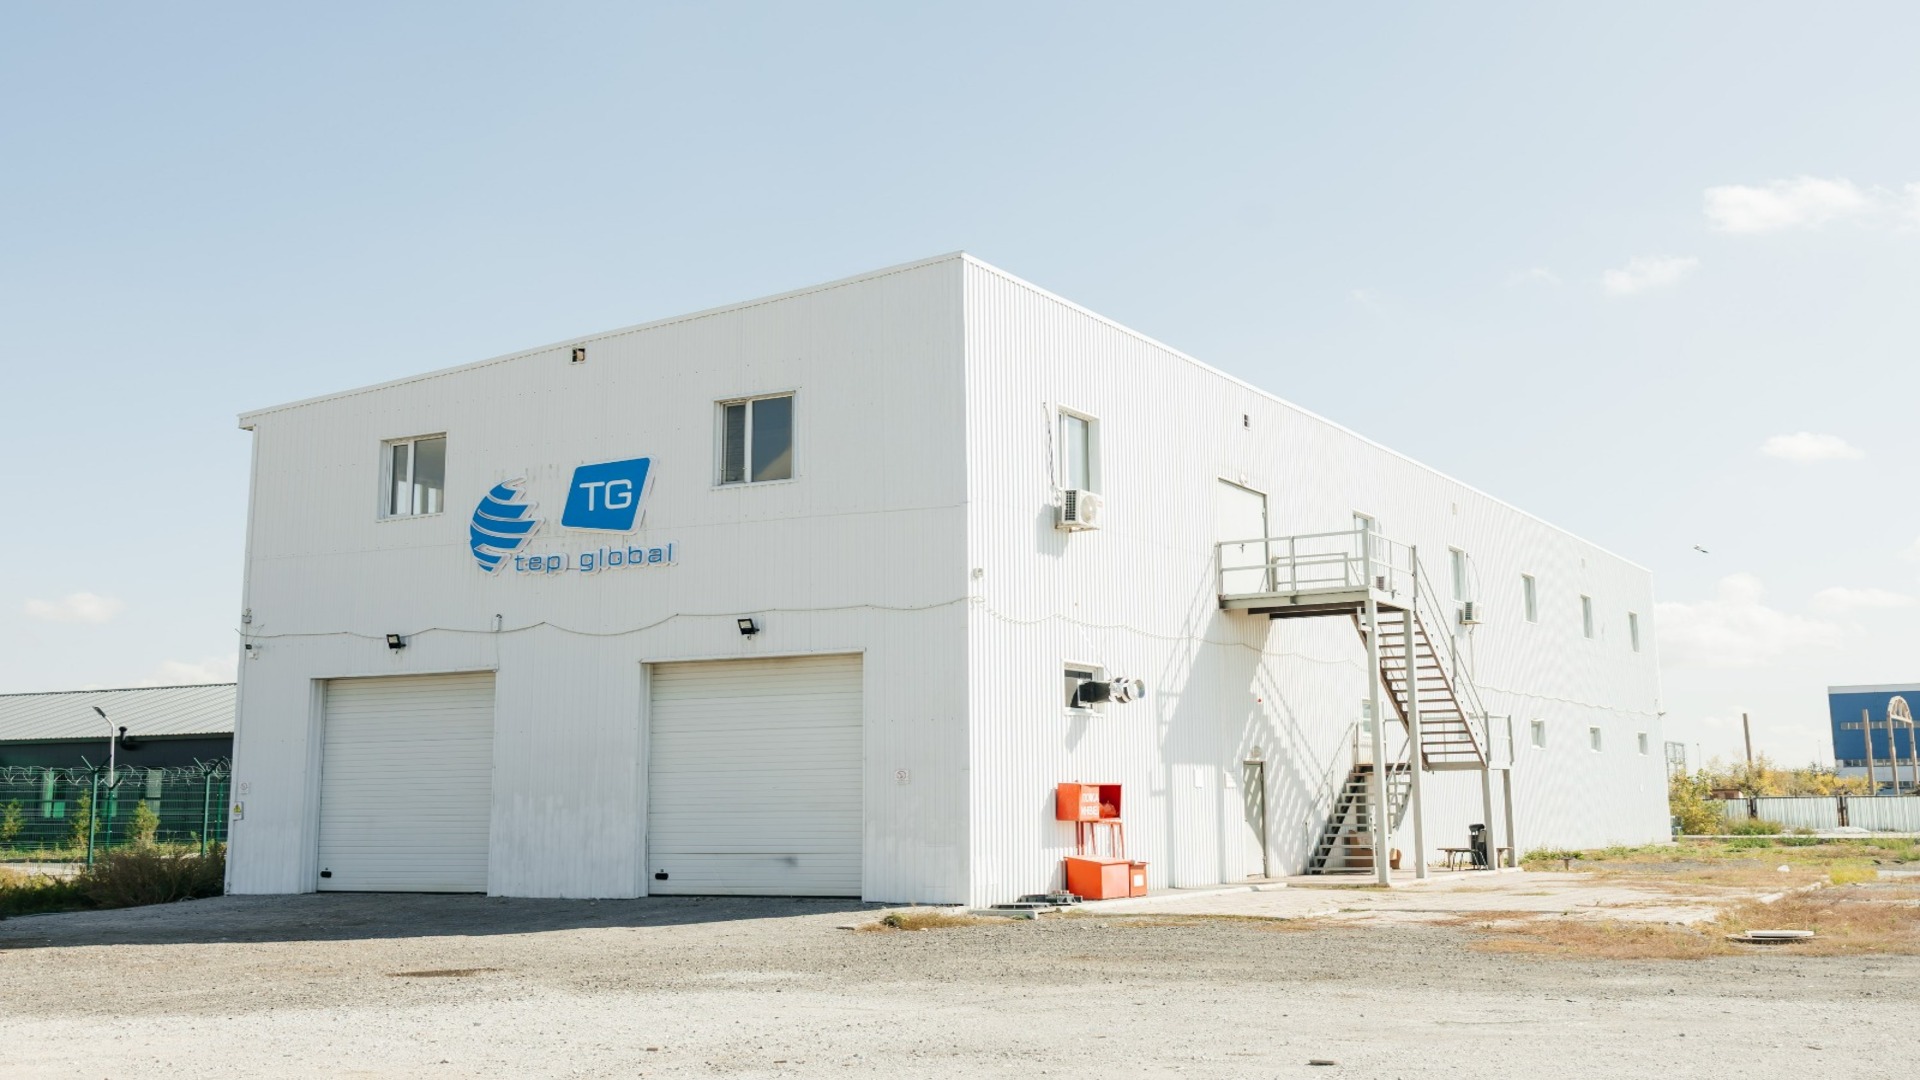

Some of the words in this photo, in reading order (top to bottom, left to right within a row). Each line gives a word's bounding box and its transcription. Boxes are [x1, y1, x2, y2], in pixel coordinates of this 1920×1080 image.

[579, 479, 632, 511] TG
[515, 554, 561, 573] tep
[580, 543, 672, 571] global
